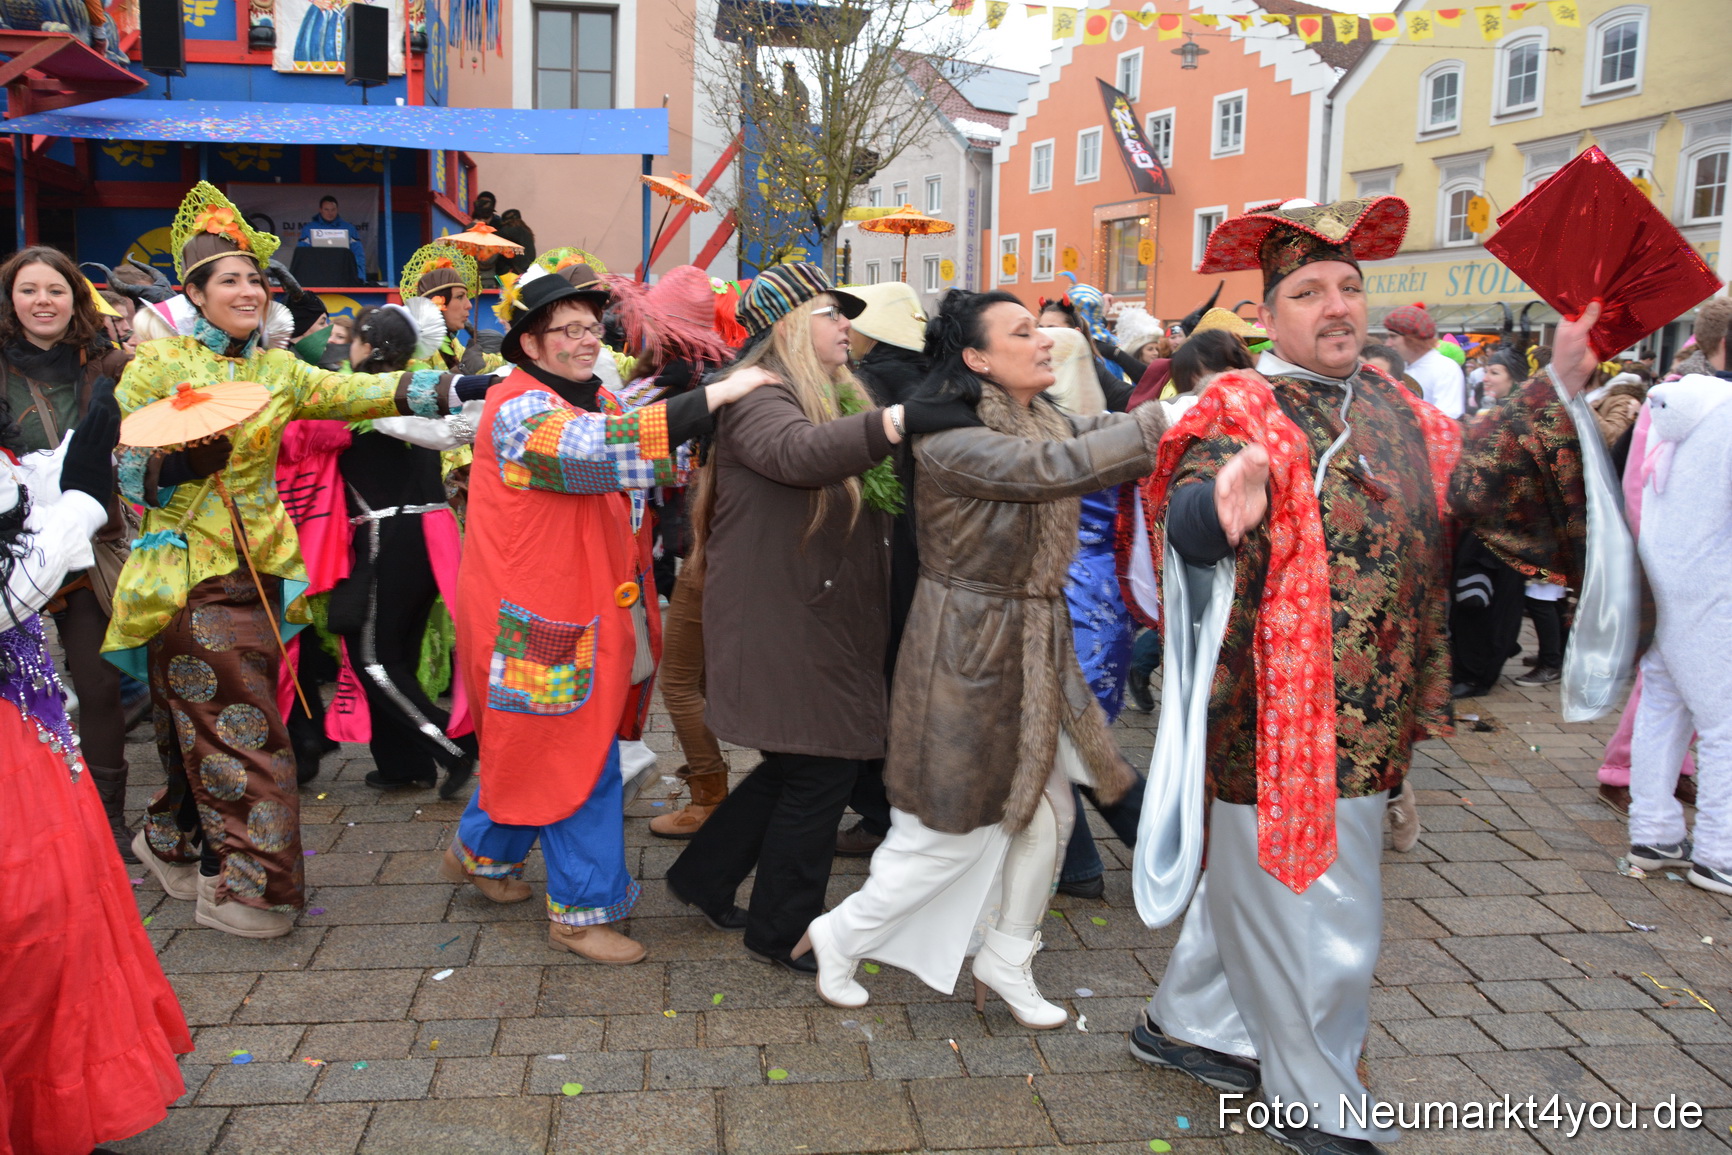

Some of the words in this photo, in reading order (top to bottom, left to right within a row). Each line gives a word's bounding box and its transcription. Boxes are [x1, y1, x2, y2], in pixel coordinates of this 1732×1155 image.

[283, 222, 297, 231] DJ
[966, 188, 976, 238] UHREN
[965, 243, 974, 292] SCHMU
[1364, 271, 1428, 295] CKEREI
